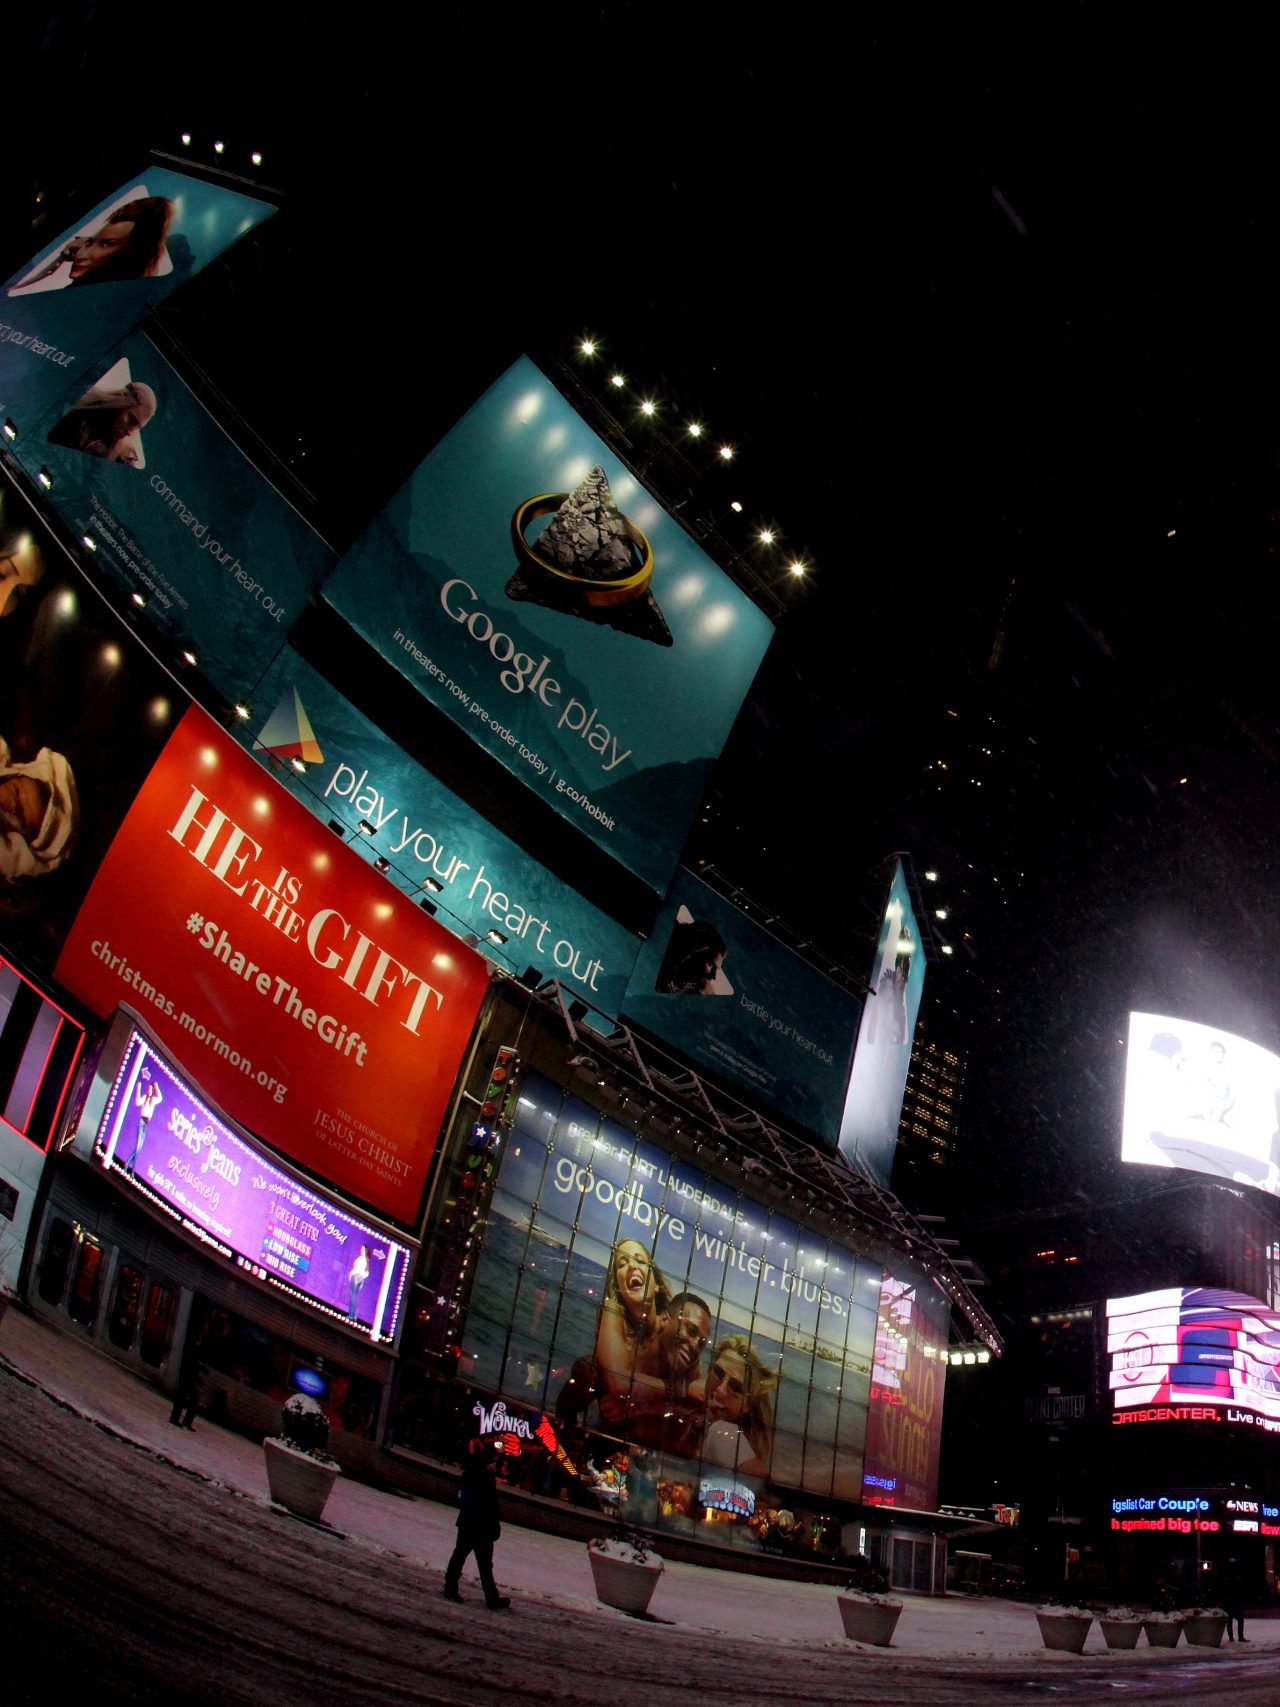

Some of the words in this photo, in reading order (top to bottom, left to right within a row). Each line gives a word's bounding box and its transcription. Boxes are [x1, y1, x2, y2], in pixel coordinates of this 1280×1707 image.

[150, 475, 209, 538] command
[200, 534, 233, 565] your
[229, 559, 265, 600] heart
[261, 596, 286, 623] out
[441, 578, 560, 707] Google
[557, 698, 632, 771] play
[393, 627, 405, 643] in
[401, 637, 447, 683] theaters
[444, 679, 470, 709] now,
[468, 700, 520, 749] pre-order
[518, 744, 549, 777] today
[554, 778, 616, 832] g.co/hobbit
[166, 784, 263, 897] HE
[247, 878, 305, 944] THE
[271, 866, 303, 904] IS
[324, 762, 398, 830] play
[389, 816, 470, 885] your
[468, 866, 552, 954] heart
[553, 940, 605, 993] out
[185, 911, 369, 1067] #ShareTheGift
[307, 908, 444, 1037] GIFT
[90, 938, 289, 1104] christmas.mormon.org
[740, 993, 769, 1022] battle
[767, 1014, 793, 1038] your
[790, 1027, 818, 1056] heart
[815, 1043, 834, 1066] out
[168, 1107, 201, 1154] series
[201, 1136, 242, 1187] jeans
[313, 1108, 355, 1143] JESUS
[358, 1138, 412, 1177] CHRIST
[168, 1155, 220, 1211] exclusively
[251, 1175, 267, 1189] We
[291, 1193, 327, 1226] overlook
[325, 1223, 348, 1245] you!
[618, 1148, 658, 1179] FORT
[657, 1168, 745, 1227] LAUDERDALE
[267, 1239, 284, 1255] LOW
[282, 1247, 300, 1266] RISE
[272, 1225, 312, 1256] HOURGLASS
[275, 1205, 301, 1230] GREAT
[300, 1220, 320, 1242] FITS!
[553, 1156, 686, 1242] goodbye
[781, 1258, 848, 1318] blues.
[265, 1253, 280, 1268] MID
[279, 1261, 296, 1278] RISE
[472, 1400, 534, 1439] WONKA
[1227, 1410, 1253, 1424] Live
[1255, 1415, 1265, 1426] on
[1139, 1498, 1156, 1510] Car
[1167, 1518, 1191, 1533] big
[1235, 1500, 1259, 1514] NEWS
